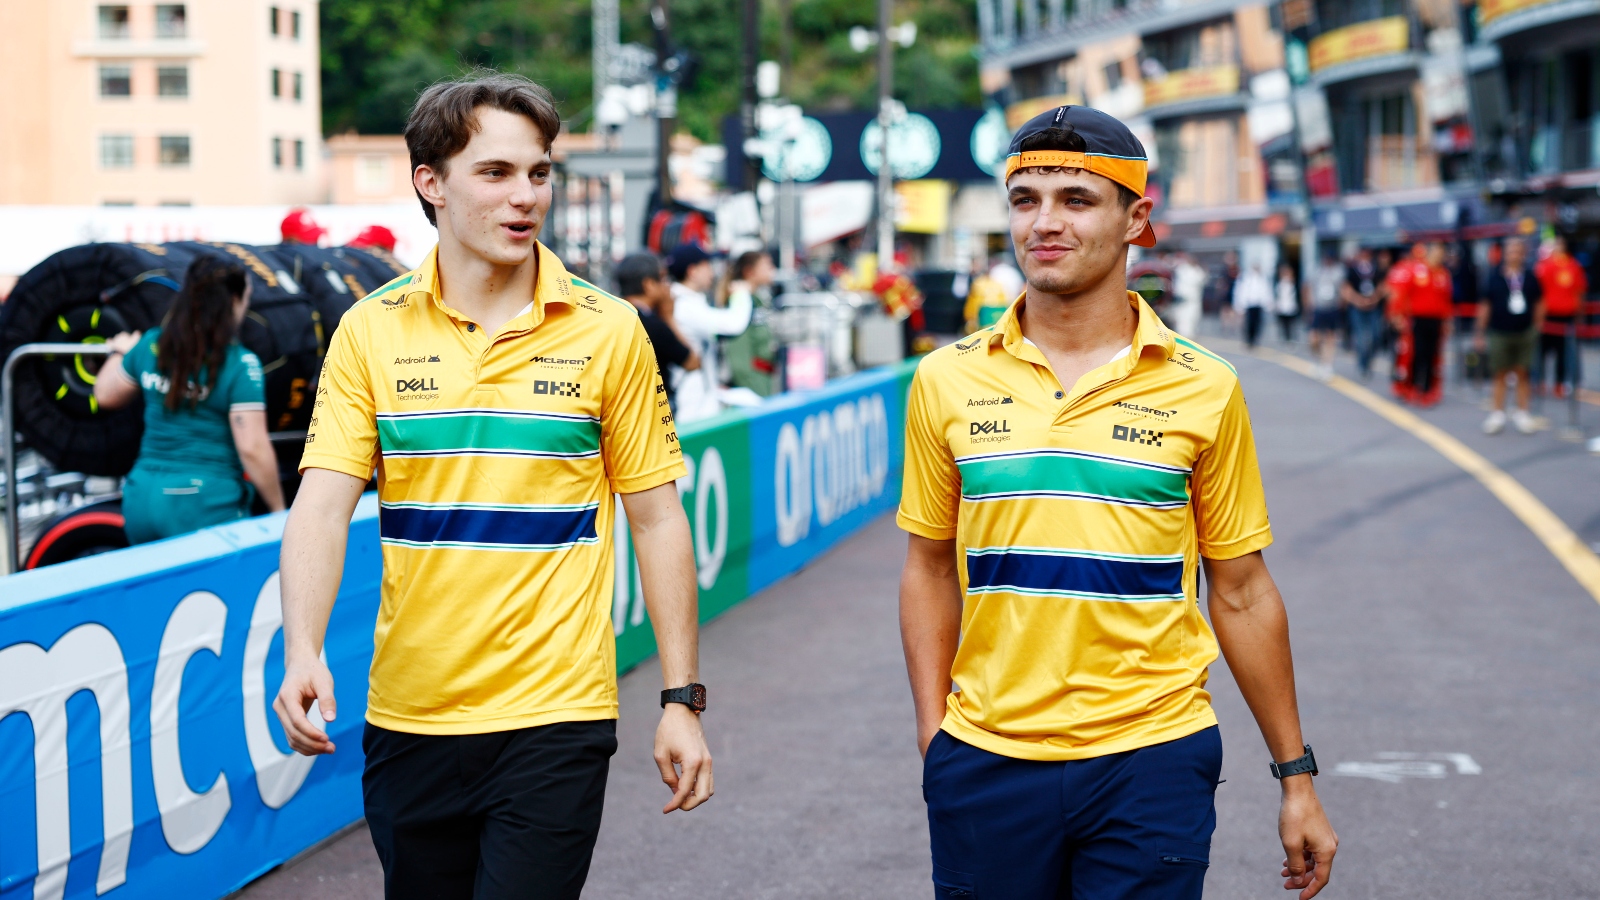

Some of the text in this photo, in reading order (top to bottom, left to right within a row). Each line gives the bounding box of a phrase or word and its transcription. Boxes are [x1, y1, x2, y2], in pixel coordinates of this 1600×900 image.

[394, 355, 426, 365] Android
[529, 356, 585, 366] McLaren
[396, 377, 439, 392] DELL
[533, 379, 581, 398] OKX
[396, 393, 439, 402] Technologies
[966, 397, 1000, 408] Android
[1111, 401, 1170, 419] McLaren
[969, 419, 1011, 435] DELL
[969, 435, 1011, 444] Technologies
[1111, 424, 1164, 448] OKX
[774, 392, 888, 547] aramco
